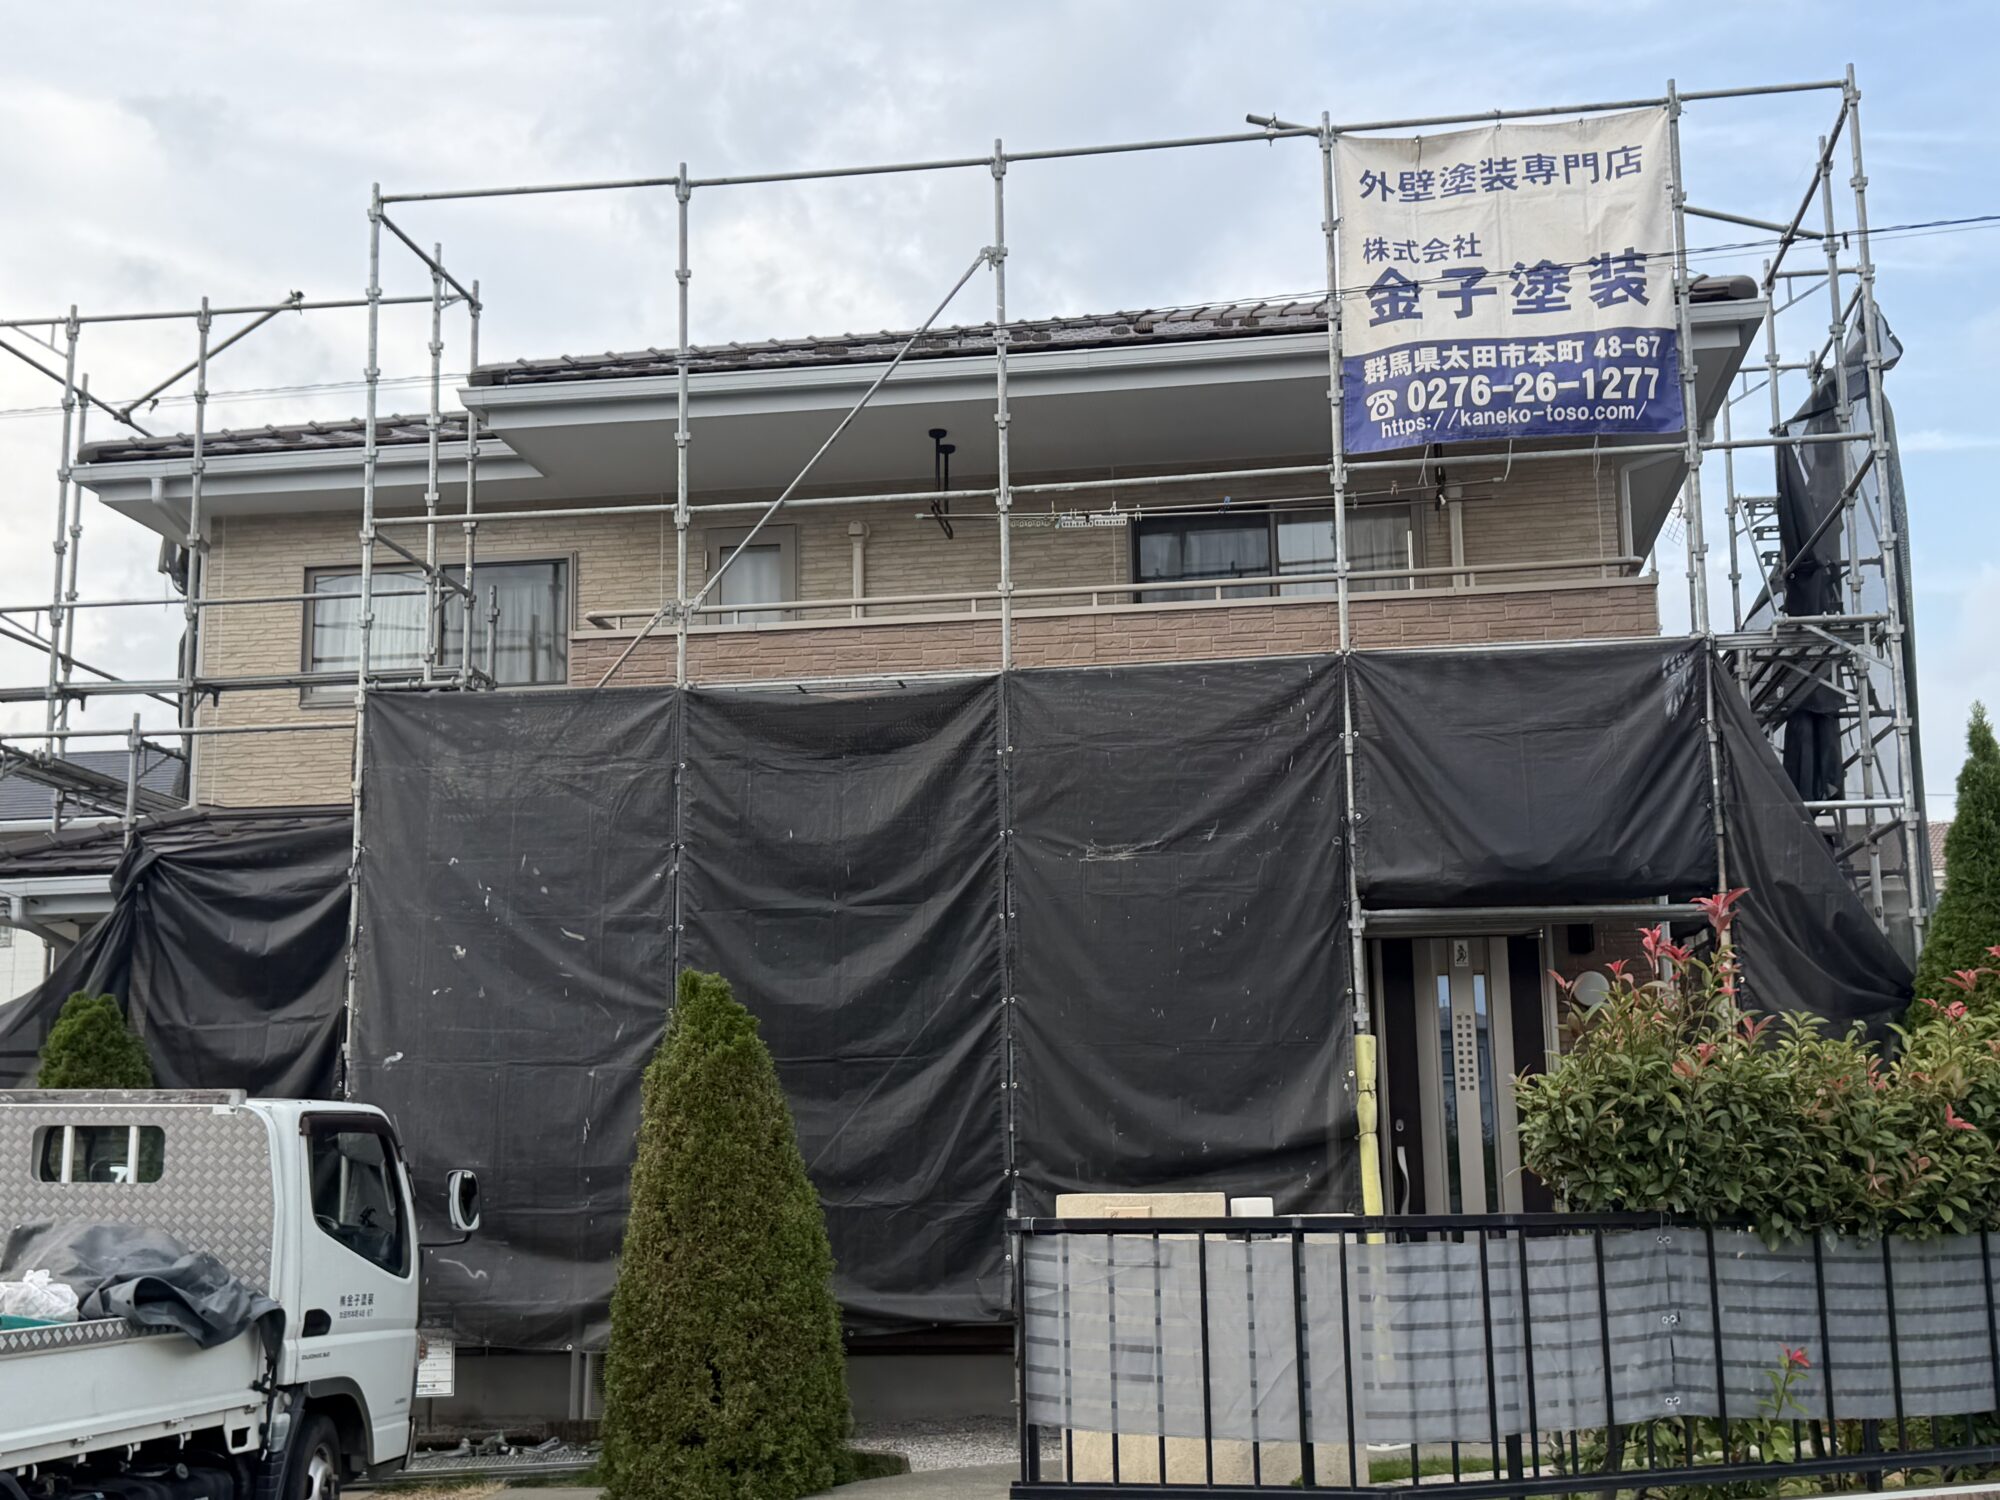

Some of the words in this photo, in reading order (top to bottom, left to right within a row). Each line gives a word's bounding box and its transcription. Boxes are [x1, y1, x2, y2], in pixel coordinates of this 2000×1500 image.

[1359, 145, 1643, 203] 外壁塗装専門店
[1362, 232, 1483, 265] 株式会社
[1365, 247, 1651, 328] 金子塗装
[1364, 340, 1584, 385] 群馬県太田市本町
[1593, 335, 1662, 358] 48-67
[1406, 366, 1660, 414] 0276-26-1277
[1381, 400, 1648, 439] https://kaneko-toso.com/
